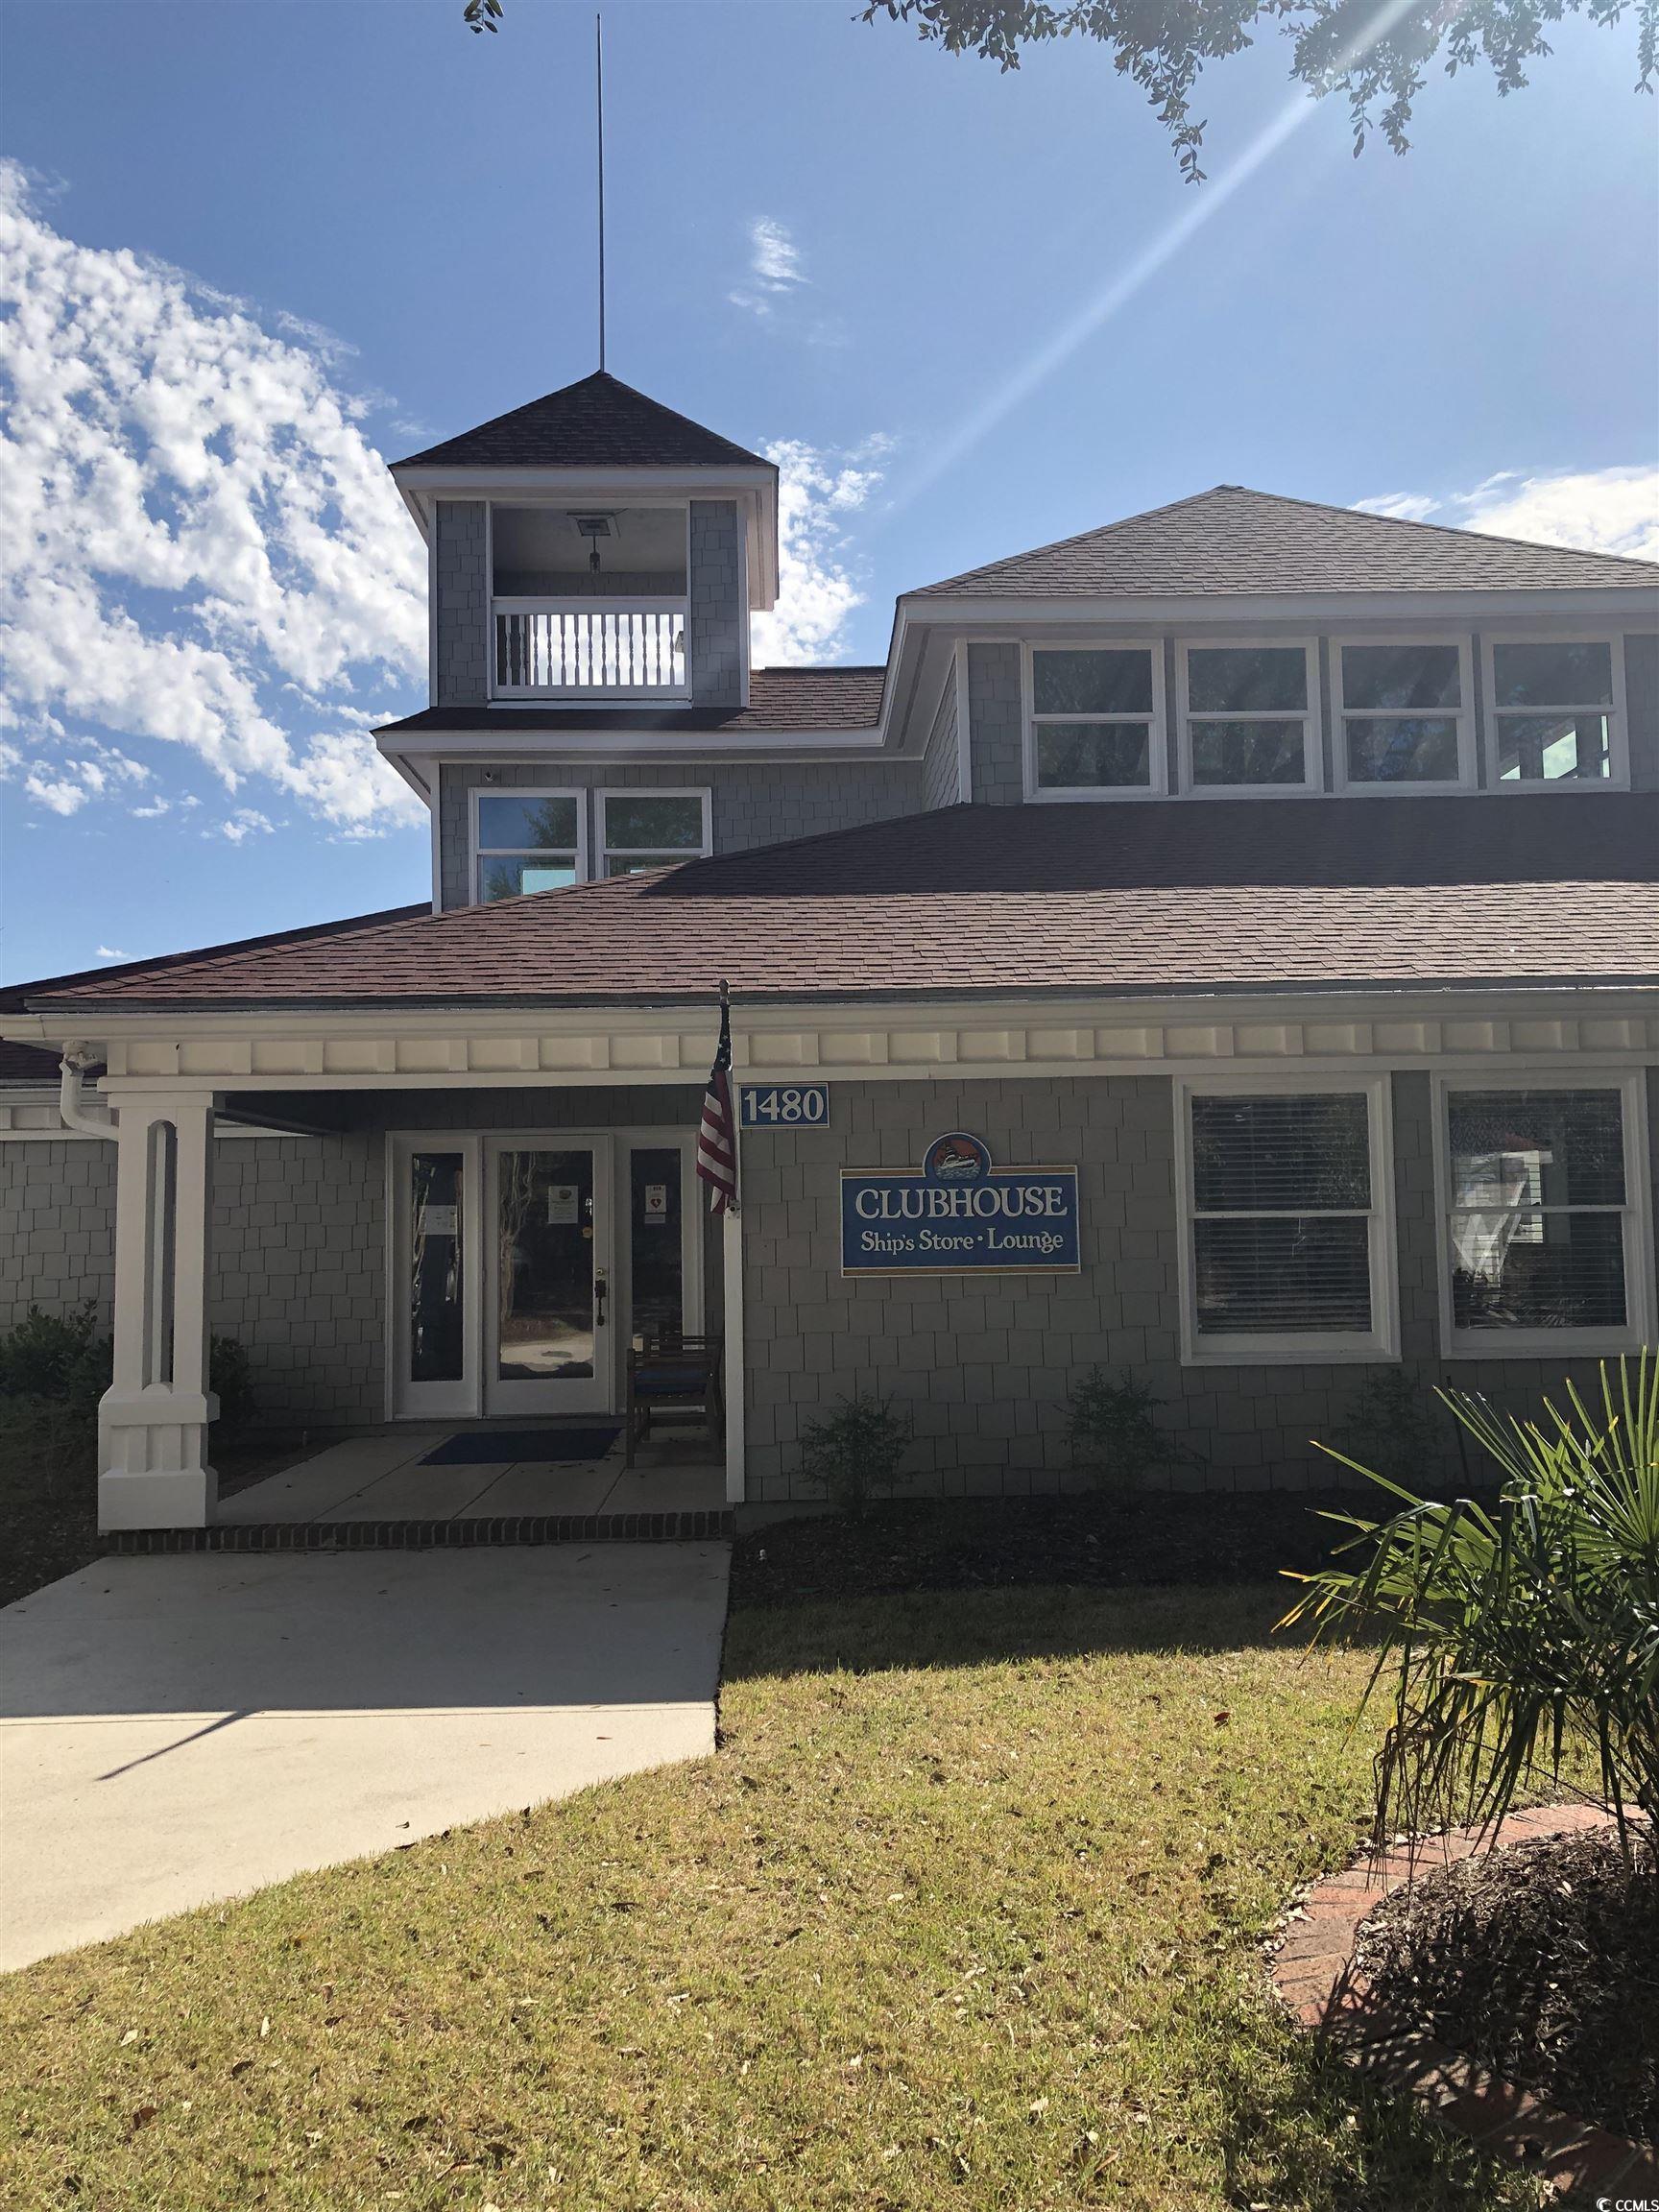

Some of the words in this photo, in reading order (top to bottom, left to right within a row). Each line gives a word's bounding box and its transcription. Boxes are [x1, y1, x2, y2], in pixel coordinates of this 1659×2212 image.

[745, 1089, 824, 1121] 1480
[855, 1187, 1068, 1219] CLUBHOUSE
[860, 1230, 914, 1256] Ship's
[919, 1229, 974, 1251] Store
[987, 1227, 1064, 1254] Lounge
